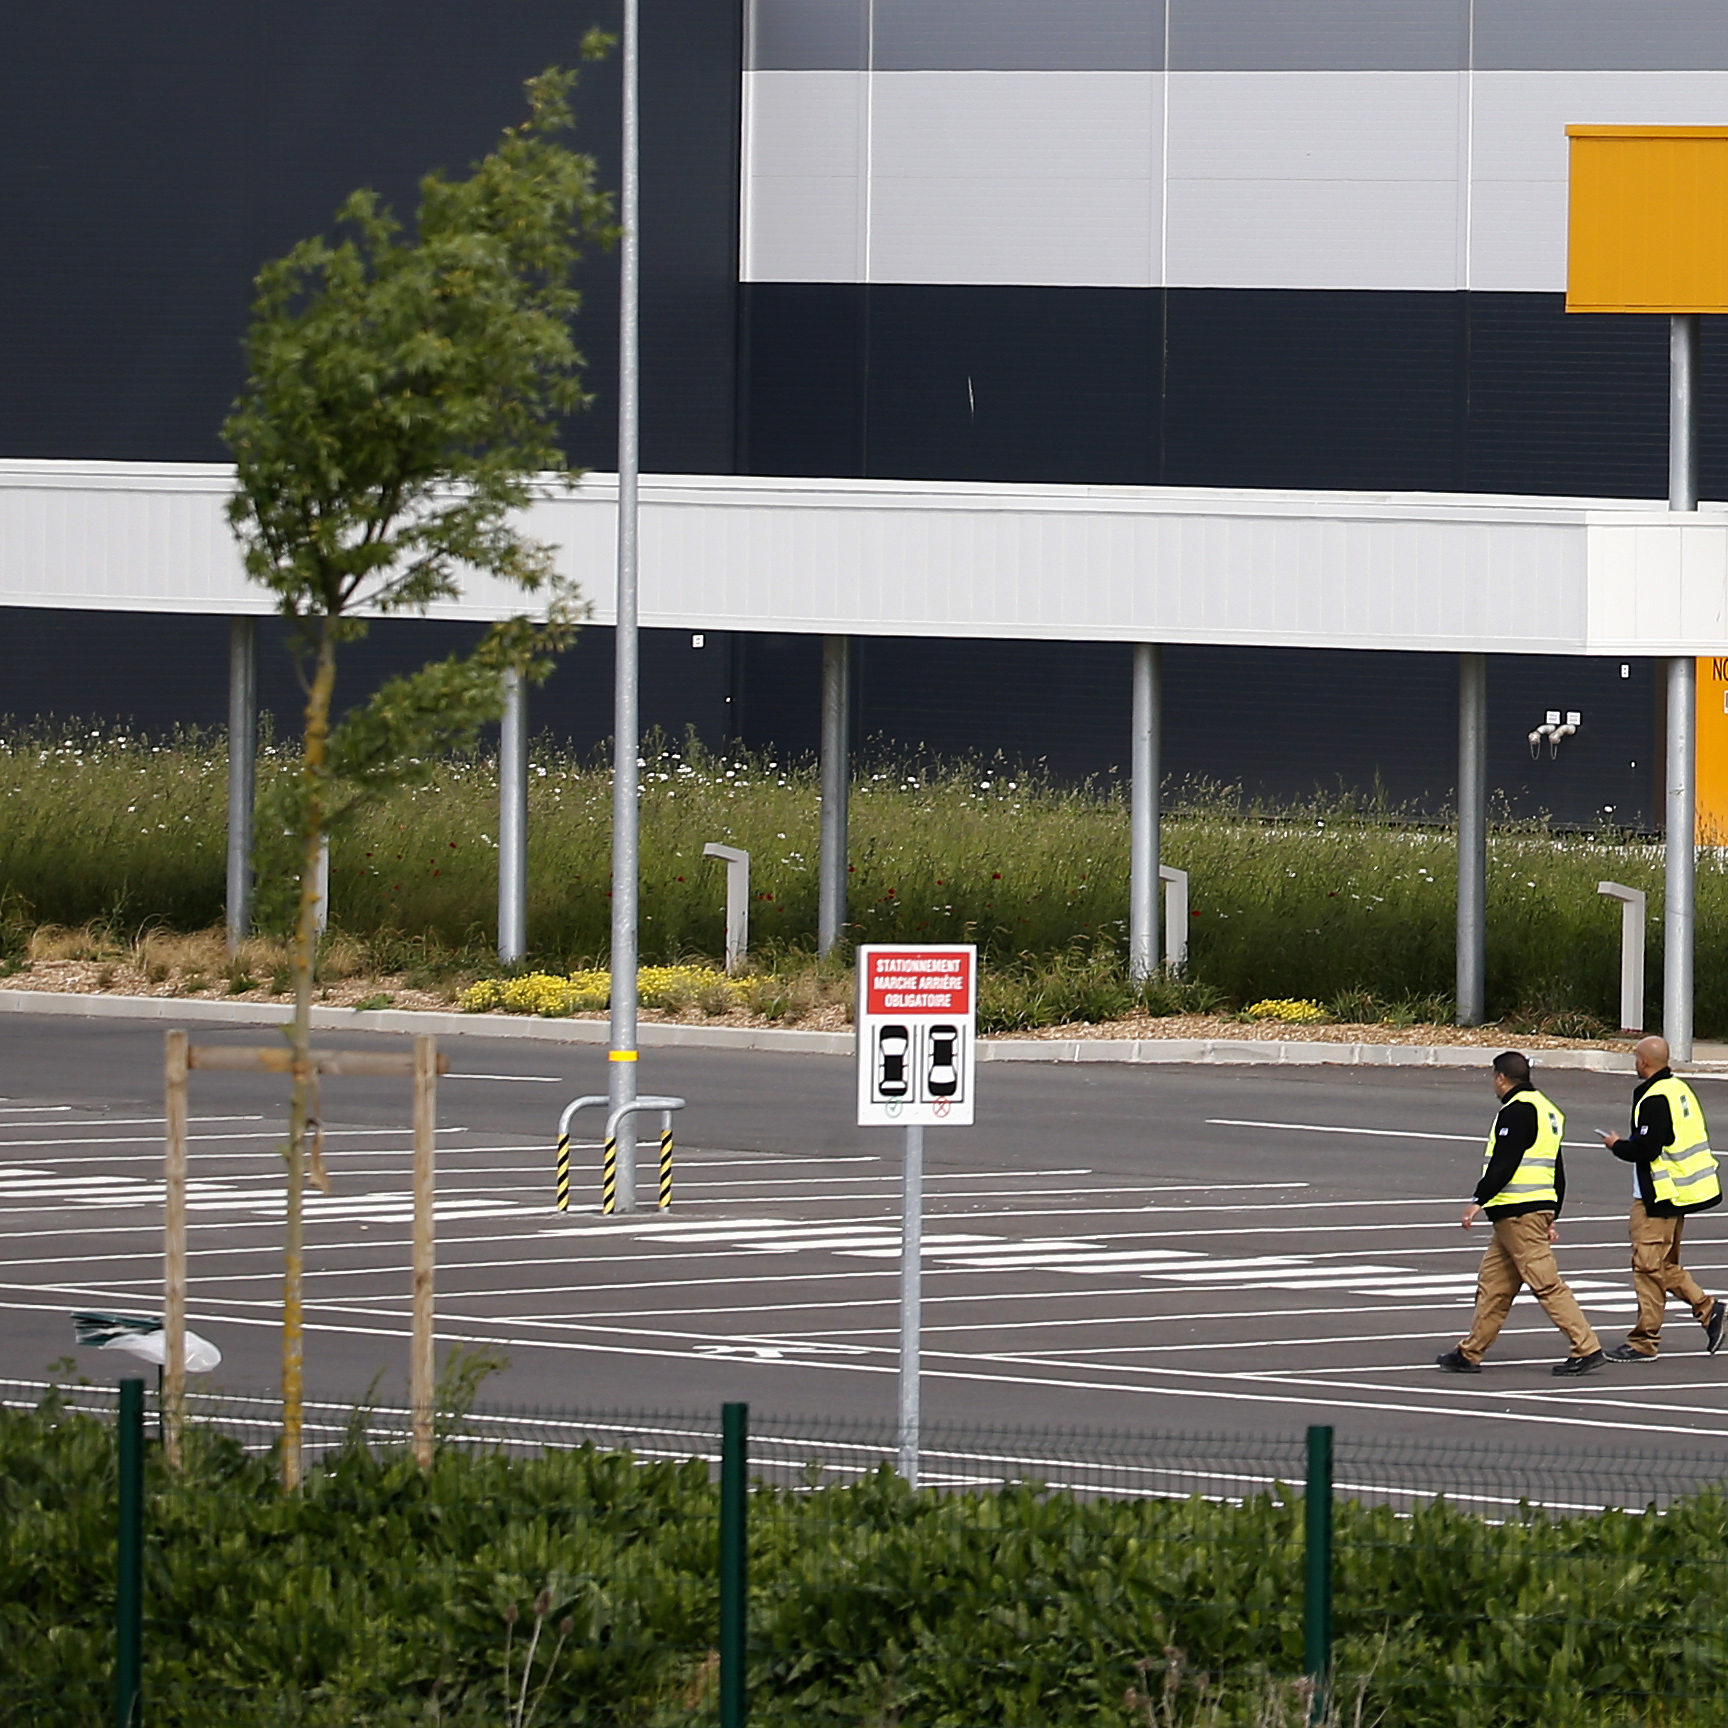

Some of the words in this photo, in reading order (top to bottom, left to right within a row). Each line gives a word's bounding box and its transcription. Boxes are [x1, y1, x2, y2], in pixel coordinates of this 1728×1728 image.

[876, 958, 961, 973] STATIONNEMENT
[873, 975, 918, 990] MARCHE
[918, 973, 963, 990] ARRIÈRE
[884, 993, 952, 1008] OBLIGATOIRE
